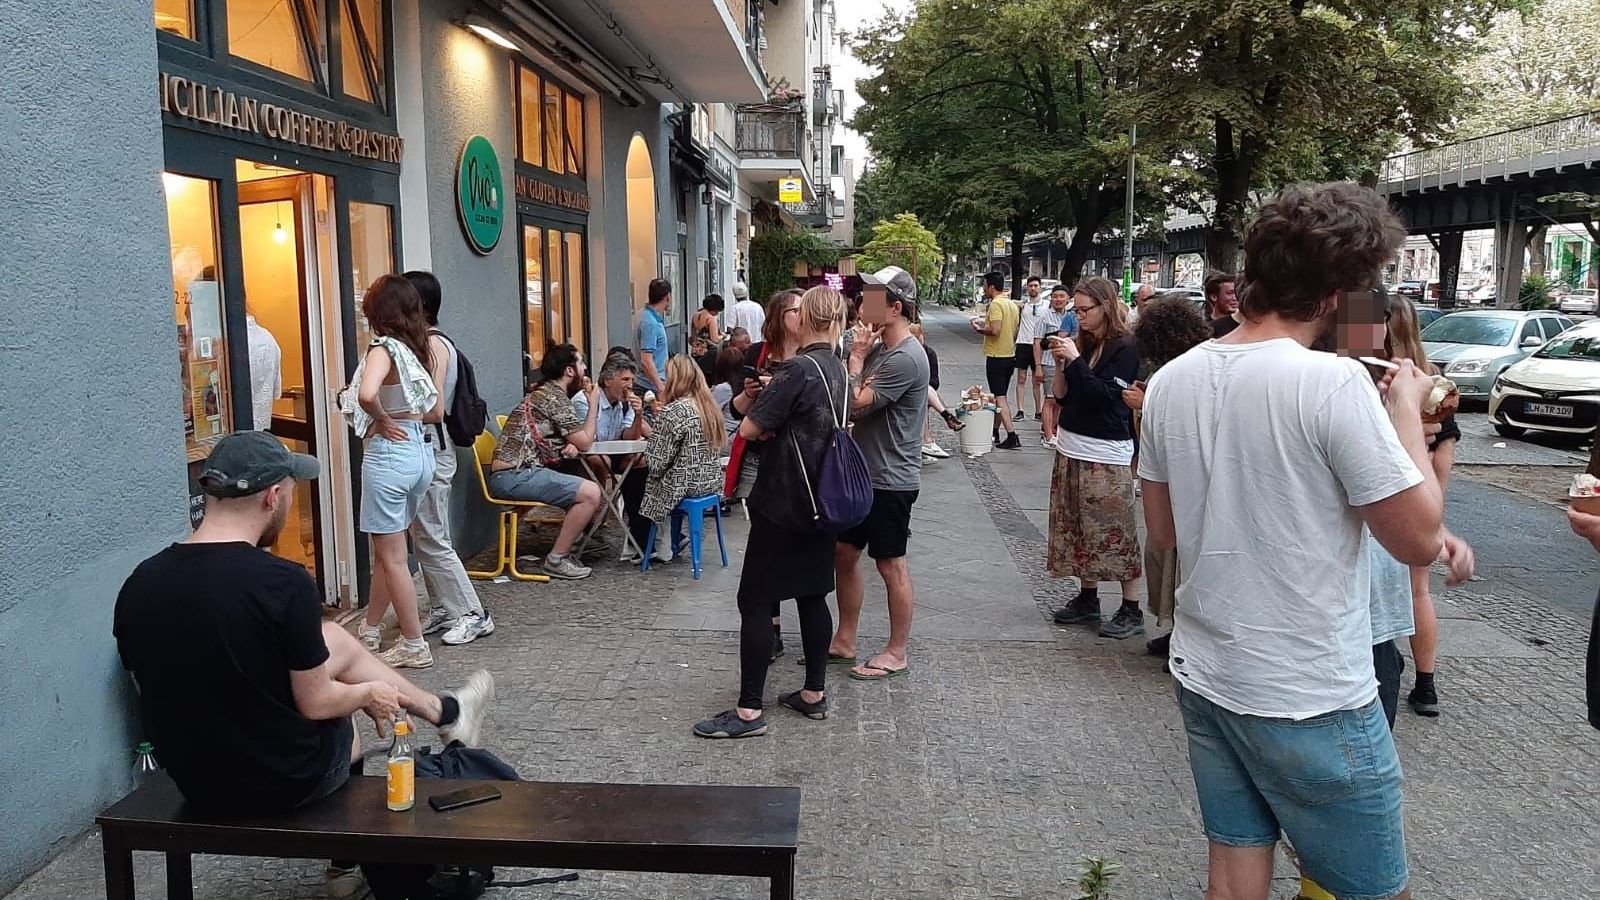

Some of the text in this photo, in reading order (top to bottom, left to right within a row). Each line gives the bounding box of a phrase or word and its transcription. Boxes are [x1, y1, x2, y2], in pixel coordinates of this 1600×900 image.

[160, 72, 405, 163] ICILIAN COFFEE & PASTRY
[529, 179, 558, 205] GLUTEN
